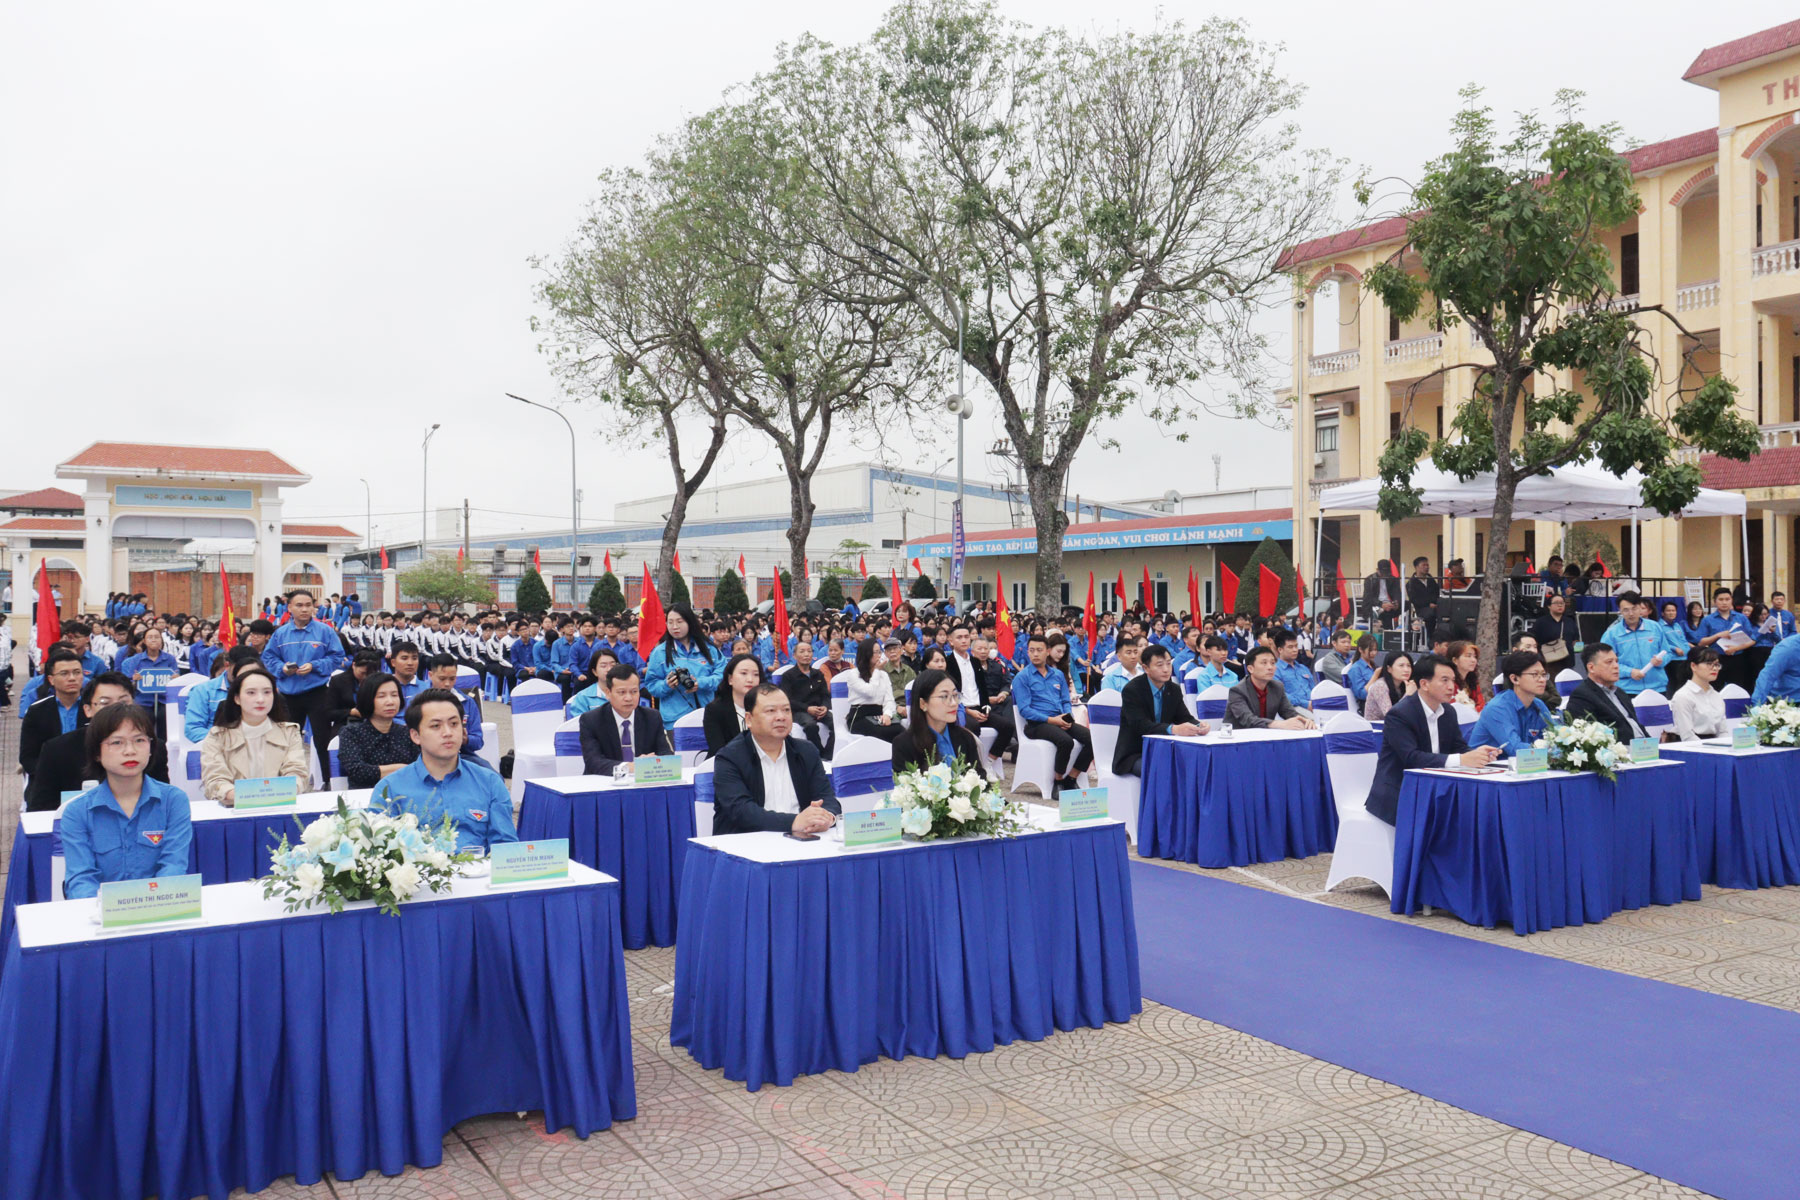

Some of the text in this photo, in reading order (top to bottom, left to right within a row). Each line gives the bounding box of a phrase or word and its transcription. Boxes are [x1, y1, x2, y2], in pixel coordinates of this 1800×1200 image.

[1083, 536, 1120, 547] NGOAN,
[1123, 534, 1142, 545] VUI
[1144, 532, 1170, 543] CHƠI
[1208, 527, 1244, 541] MẠNH
